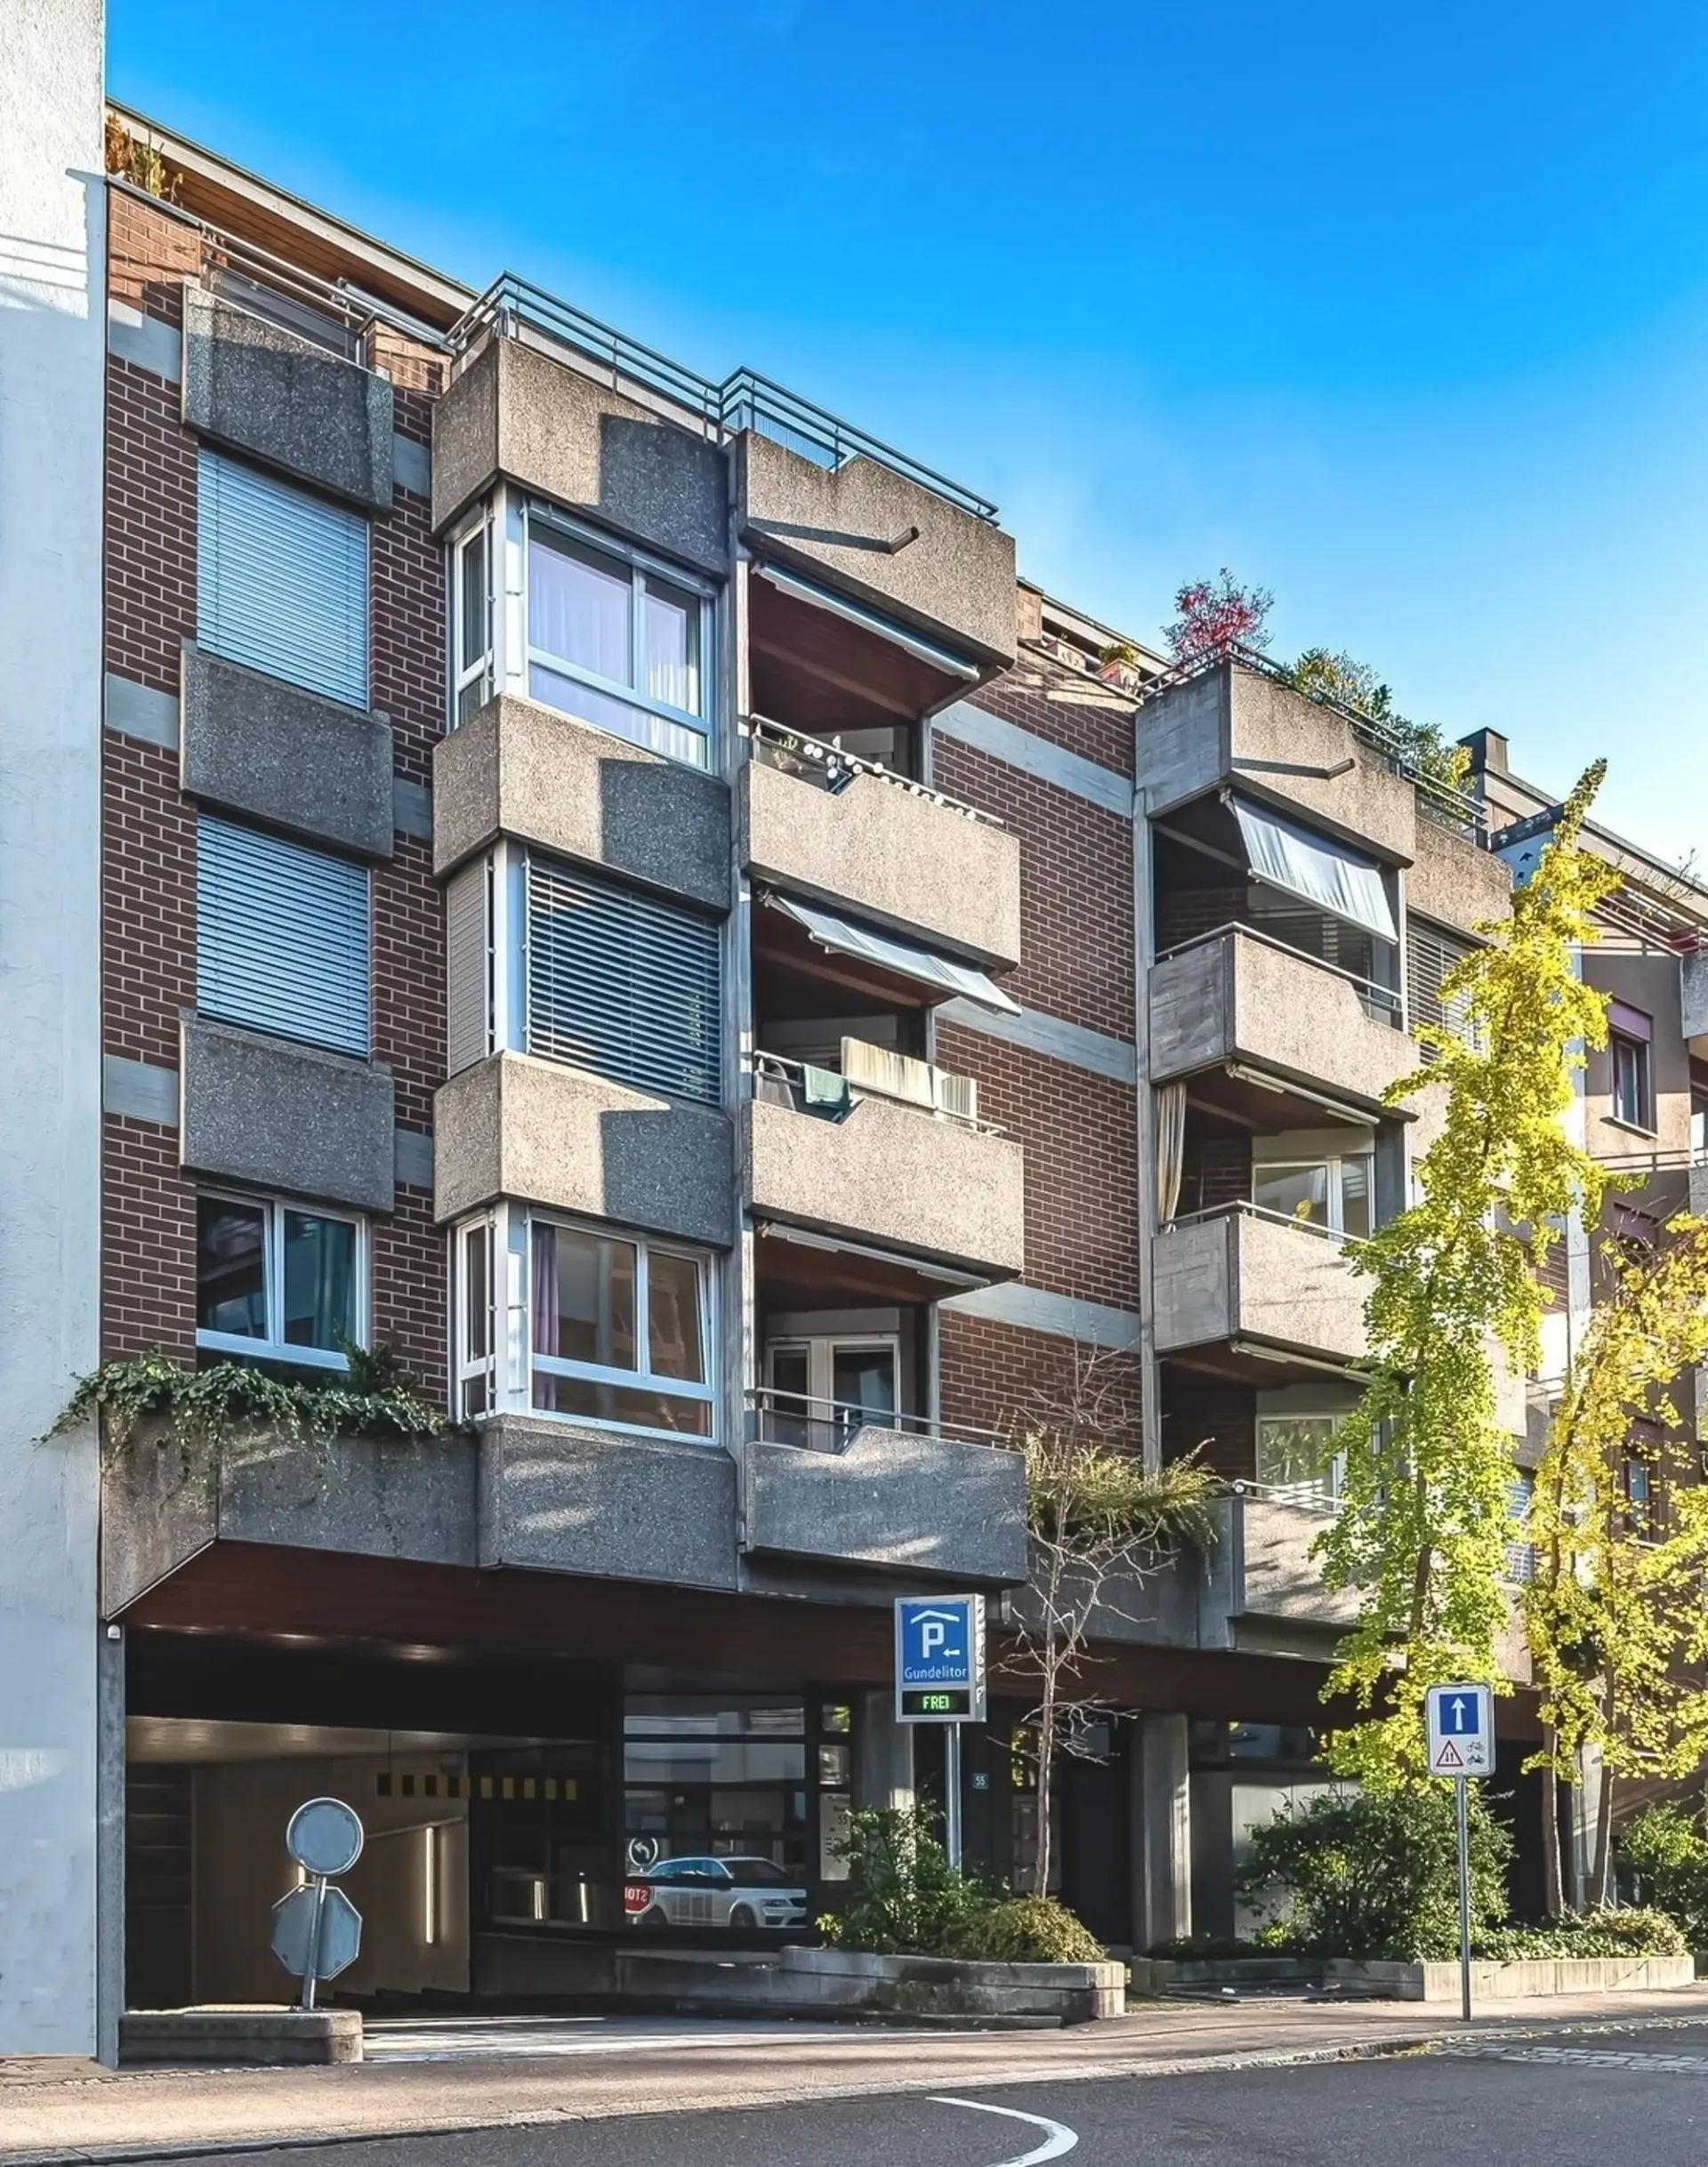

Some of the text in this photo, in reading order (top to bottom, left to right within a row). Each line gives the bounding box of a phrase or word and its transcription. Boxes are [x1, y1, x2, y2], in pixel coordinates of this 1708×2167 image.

[922, 1623, 945, 1658] P
[904, 1665, 967, 1680] Gundelitor
[922, 1696, 949, 1710] FREI
[975, 1776, 986, 1786] 55
